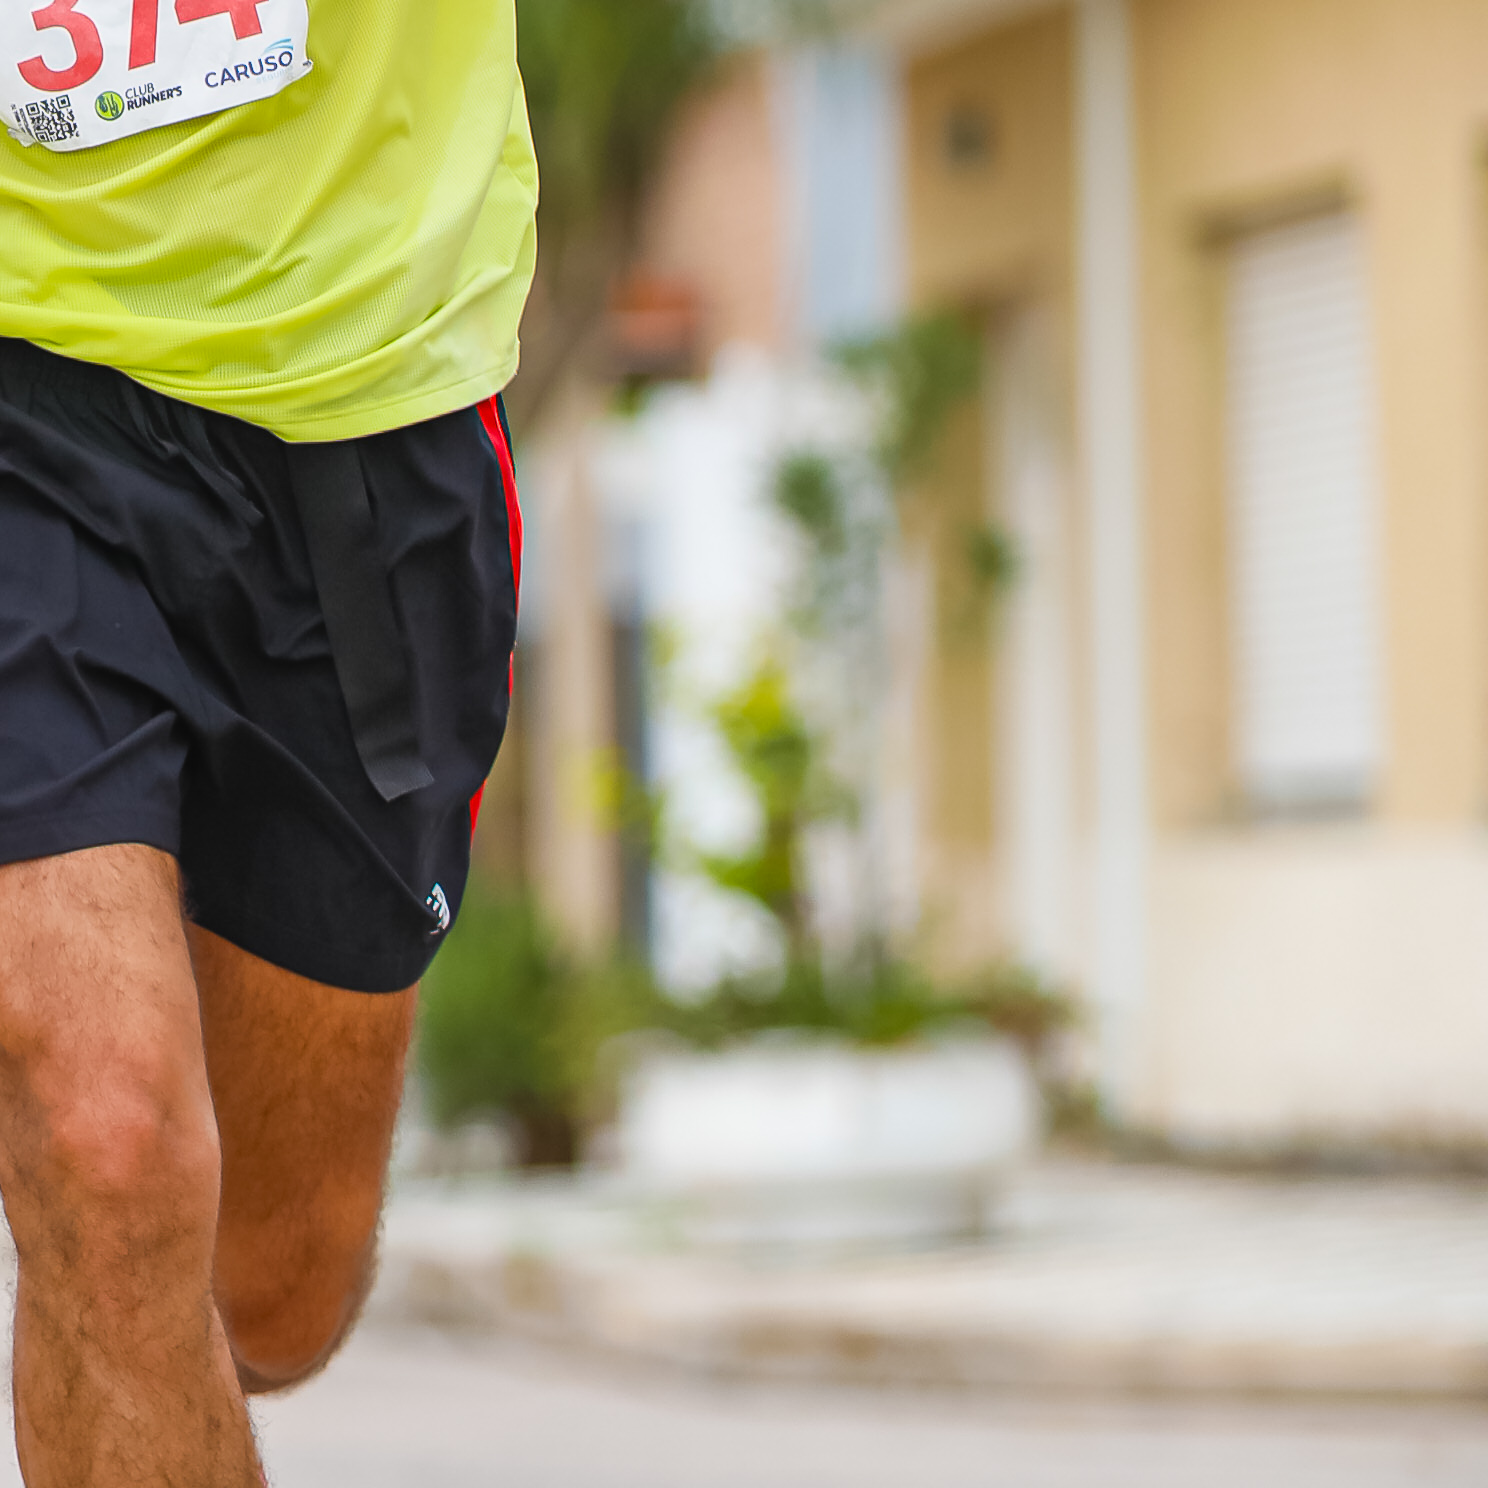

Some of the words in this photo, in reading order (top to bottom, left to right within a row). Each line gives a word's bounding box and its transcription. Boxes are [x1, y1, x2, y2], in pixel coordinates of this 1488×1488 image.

[204, 50, 293, 88] CARUSO
[125, 82, 155, 100] CLUB
[126, 85, 183, 112] RUNNER'S
